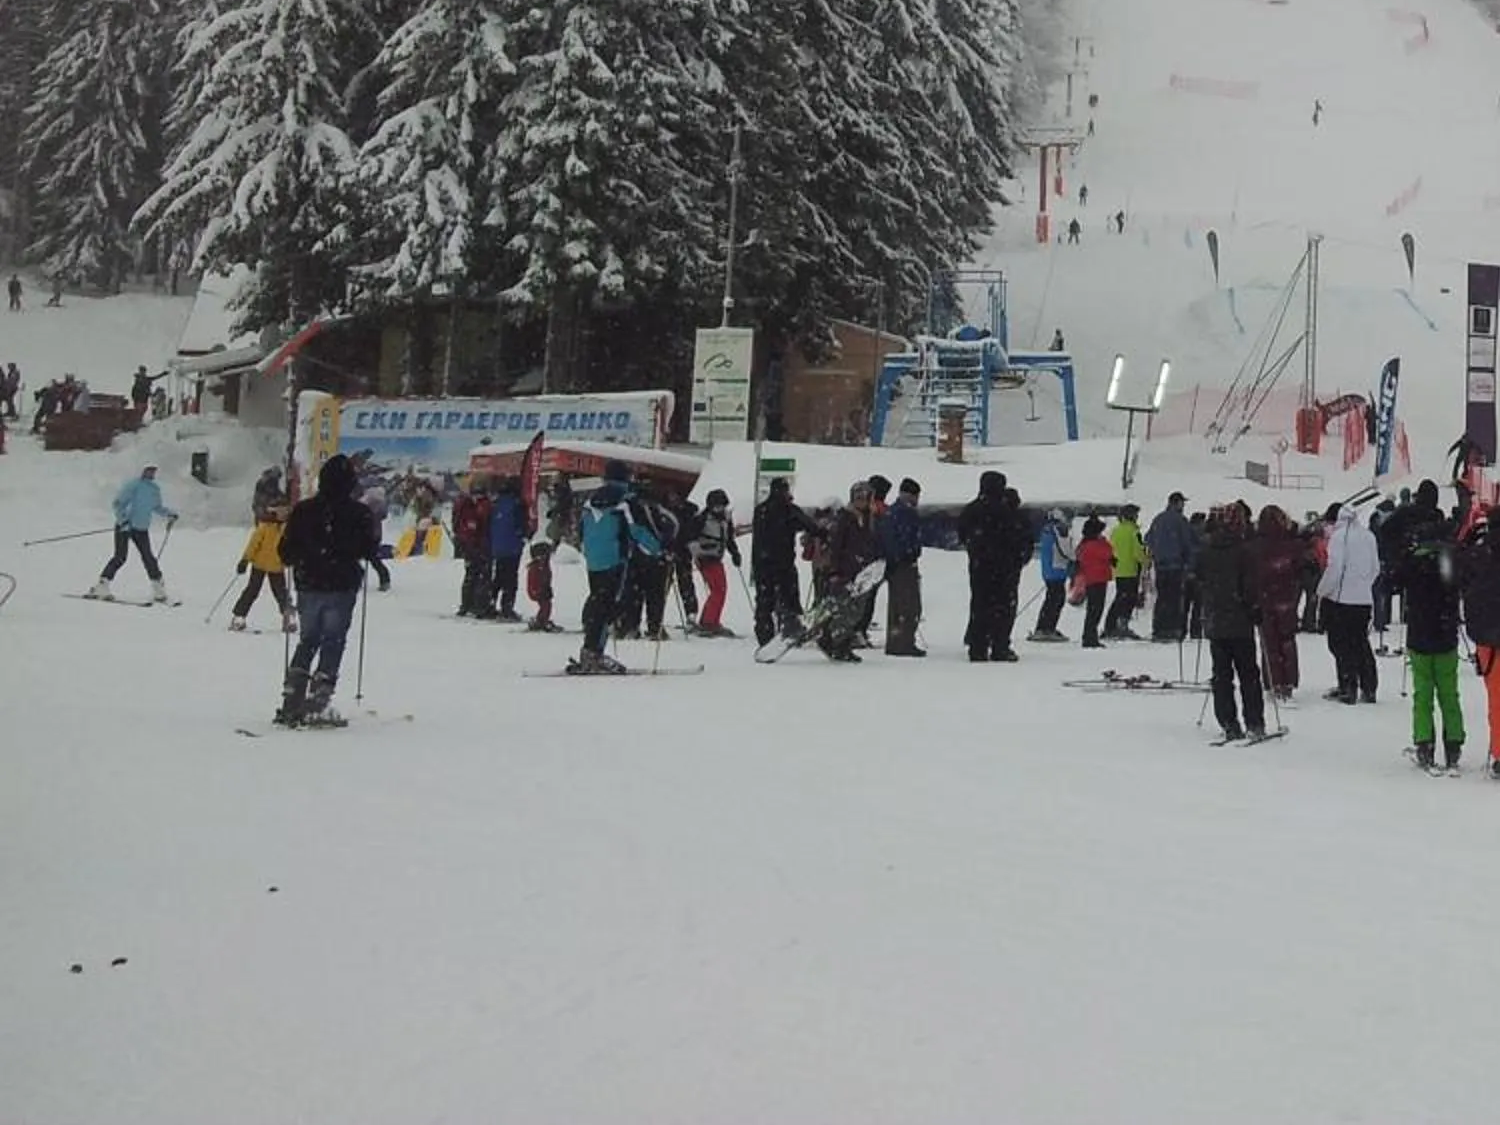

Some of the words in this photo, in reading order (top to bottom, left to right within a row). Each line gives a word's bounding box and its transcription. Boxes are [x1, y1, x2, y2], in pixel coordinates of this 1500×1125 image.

[354, 411, 409, 431] СКИ
[415, 410, 541, 432] ГАРДЕРОБ
[546, 410, 632, 431] БАНКО
